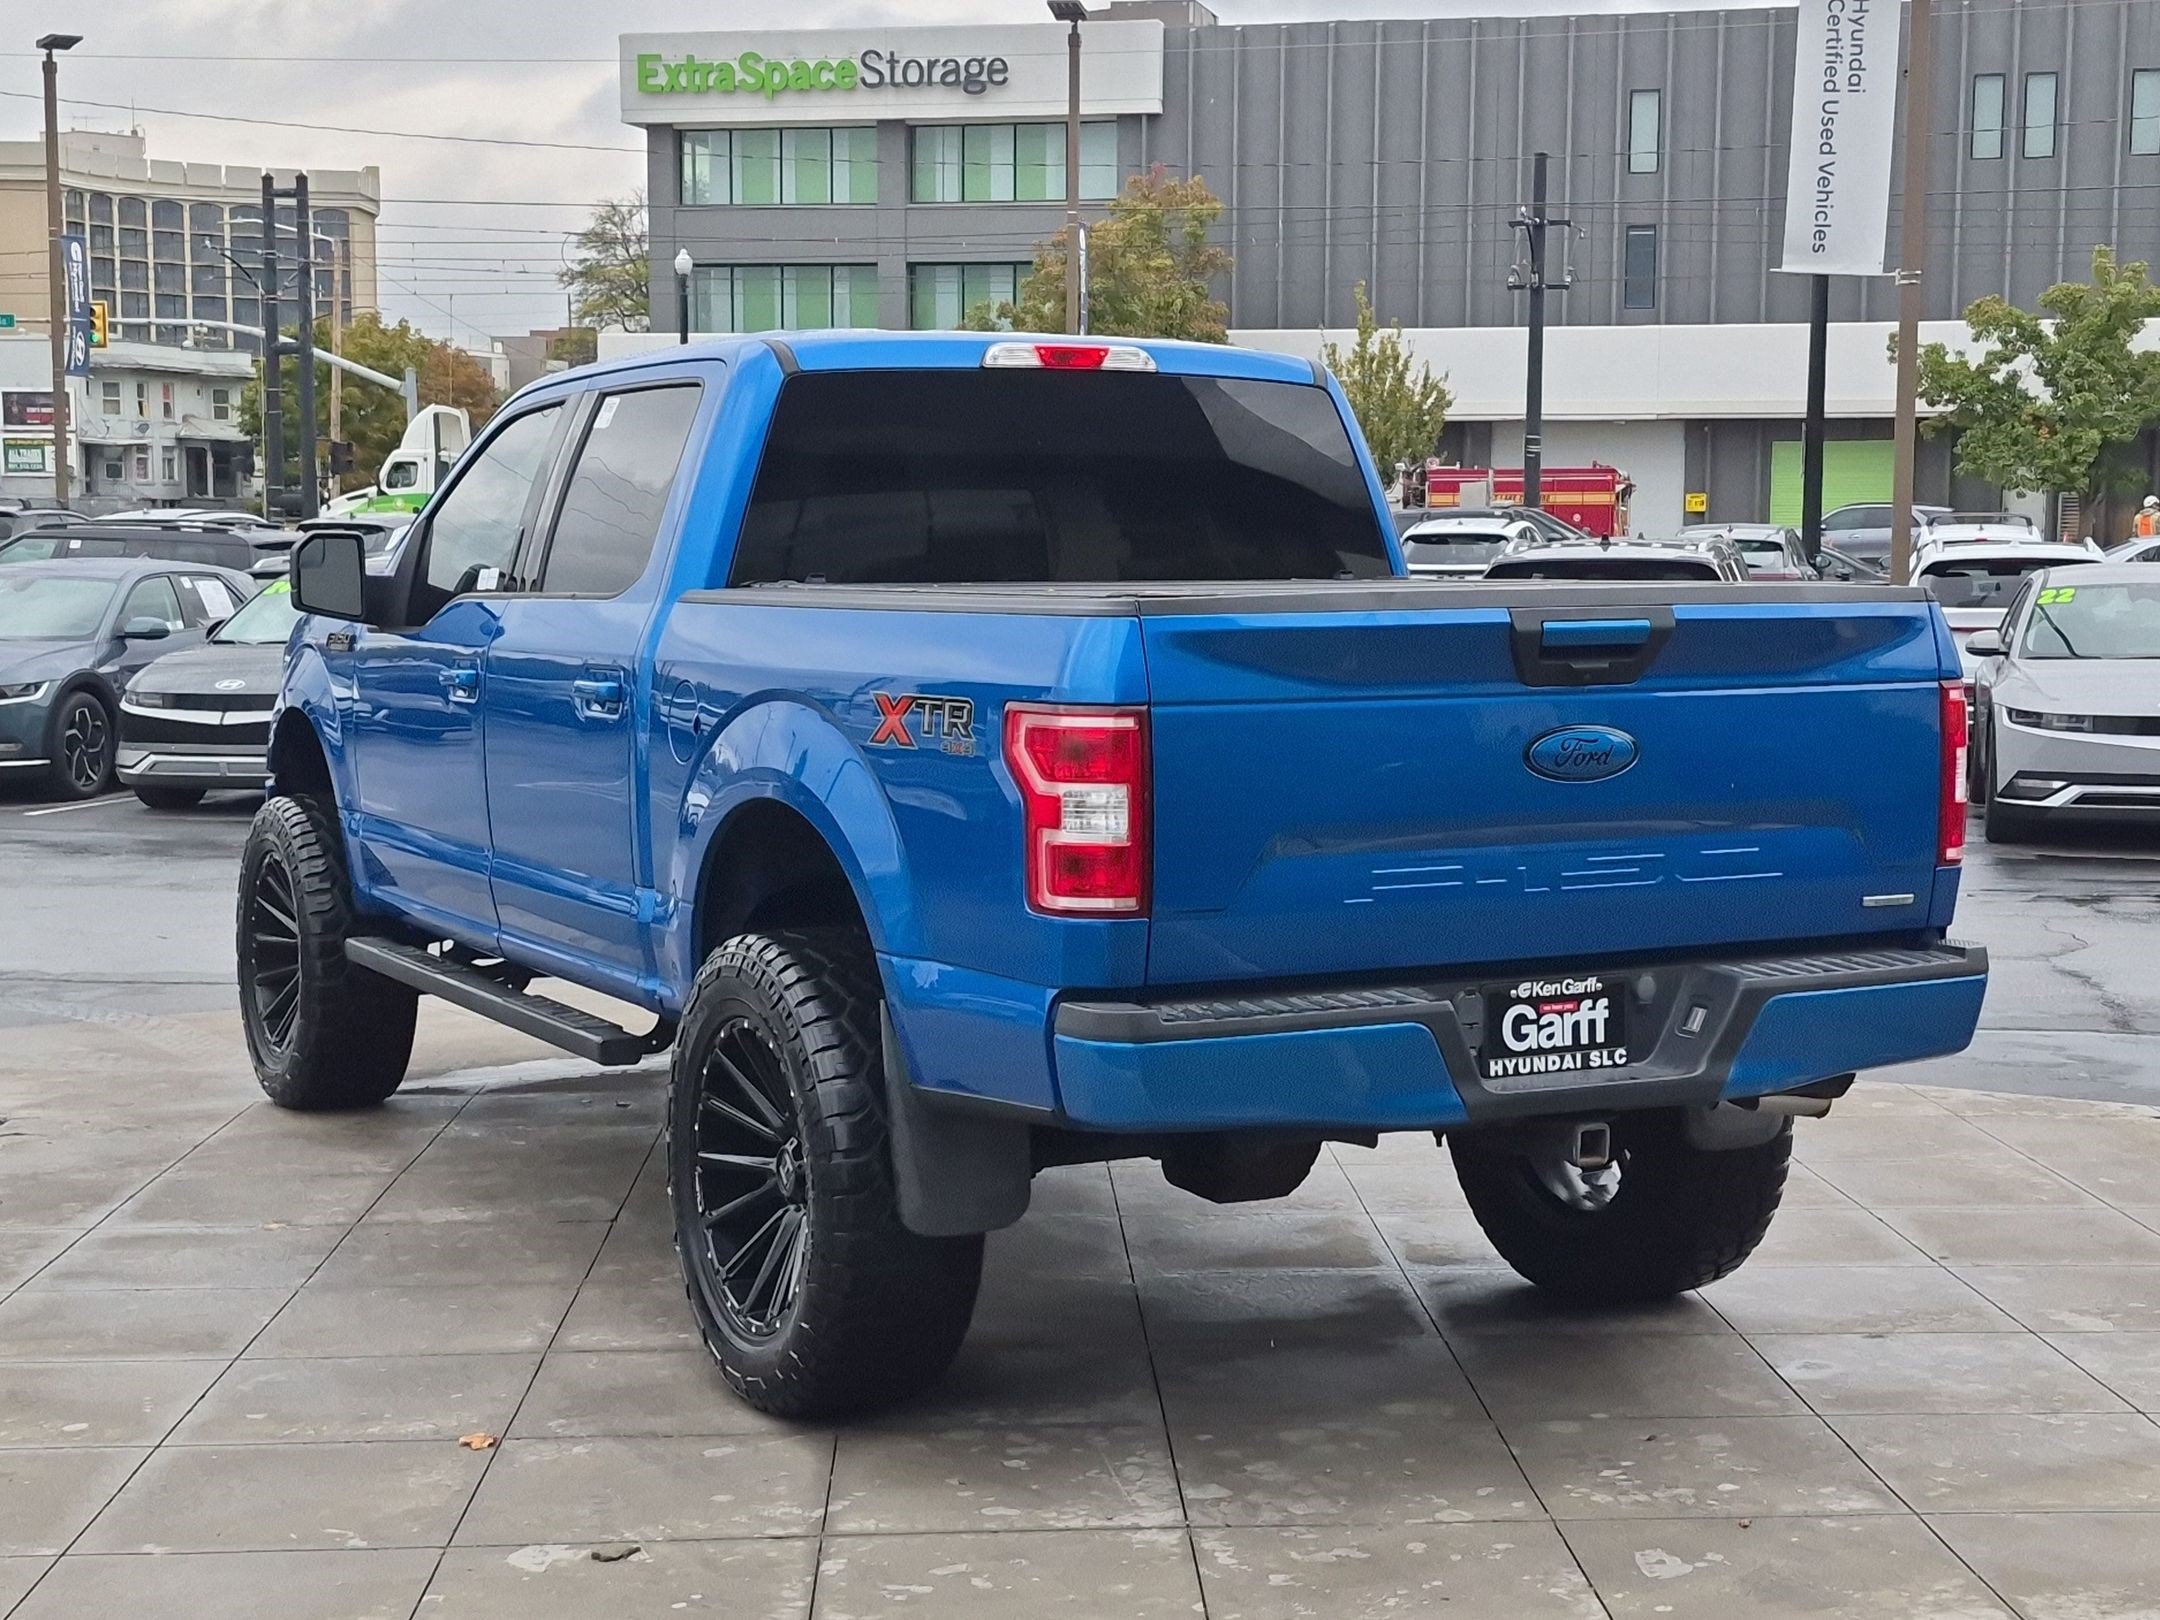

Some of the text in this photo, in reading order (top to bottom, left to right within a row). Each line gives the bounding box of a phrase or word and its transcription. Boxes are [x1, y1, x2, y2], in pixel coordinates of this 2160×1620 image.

[1847, 0, 1870, 93] Hyundai
[1812, 0, 1845, 254] Certified Used Vehicles
[2037, 588, 2076, 604] 22
[868, 688, 977, 750] XTR
[1554, 737, 1615, 768] Ford
[1532, 976, 1598, 997] Ken Garff
[1502, 997, 1610, 1052] Garff
[1489, 1047, 1627, 1077] HYUNDAI SLC
